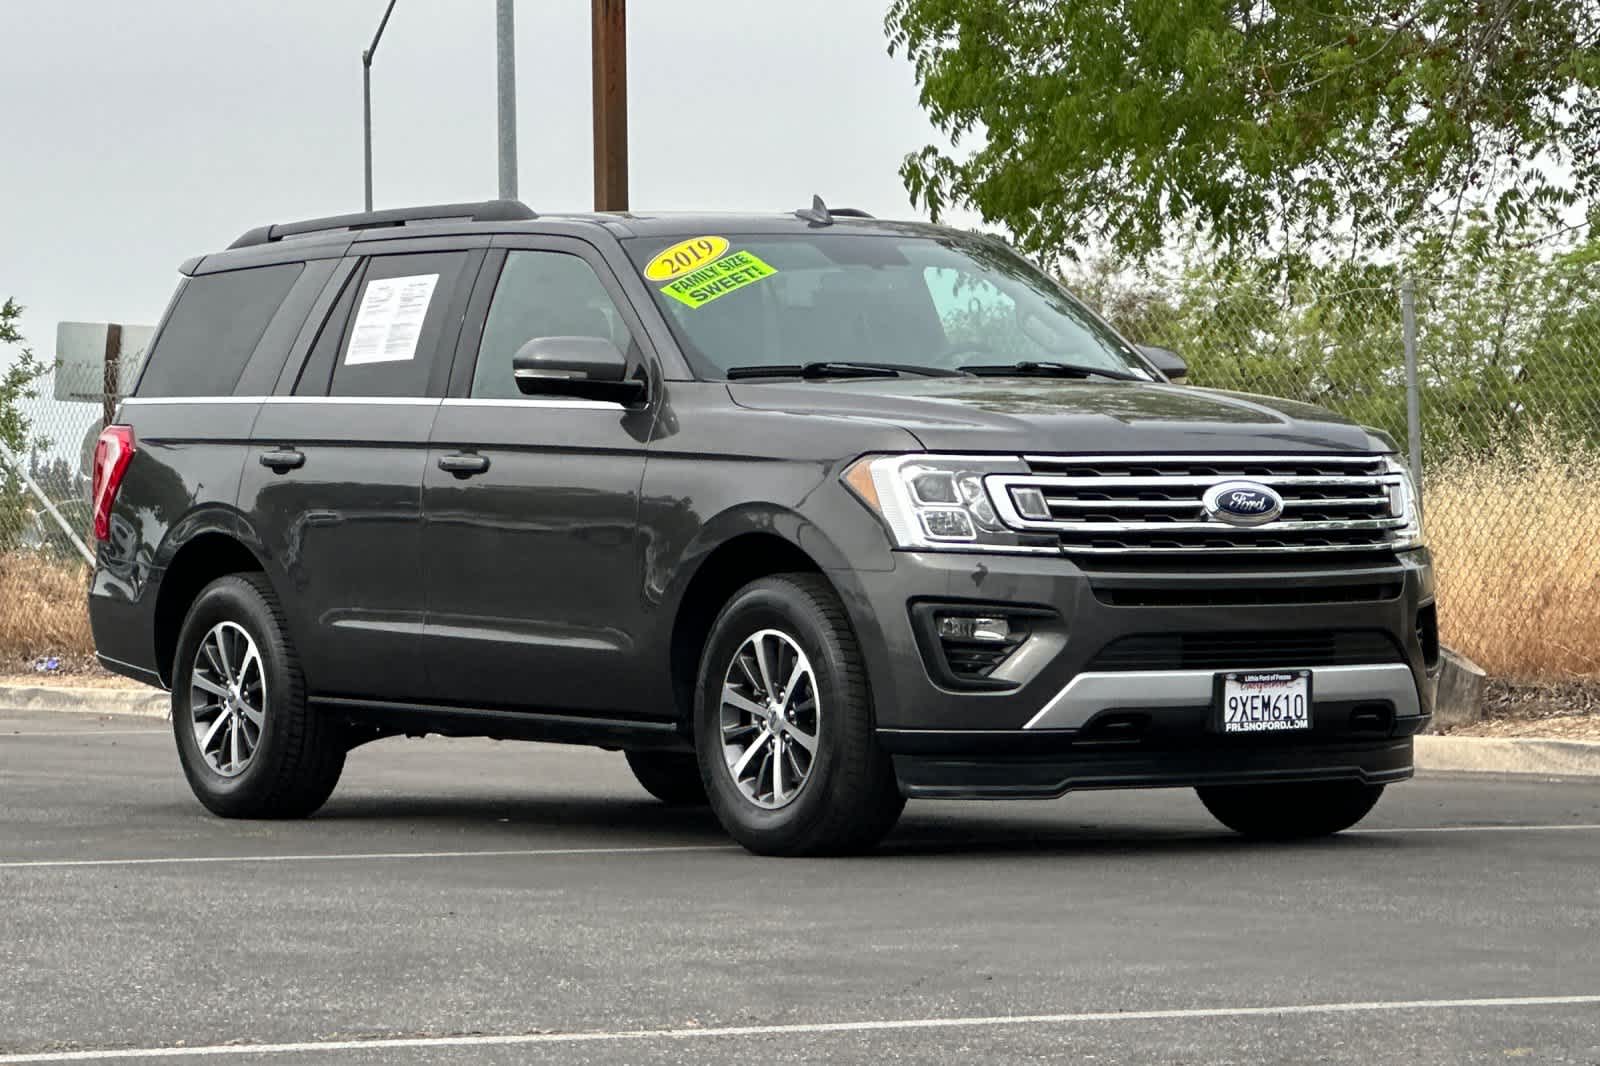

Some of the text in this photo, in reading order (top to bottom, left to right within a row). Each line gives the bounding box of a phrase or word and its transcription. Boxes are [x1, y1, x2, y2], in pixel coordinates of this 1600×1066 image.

[662, 240, 713, 274] 2019
[670, 255, 753, 293] FAMILY SIZE
[689, 265, 766, 302] SWEET!
[1229, 491, 1266, 511] Ford
[1228, 694, 1304, 722] 9XEM610
